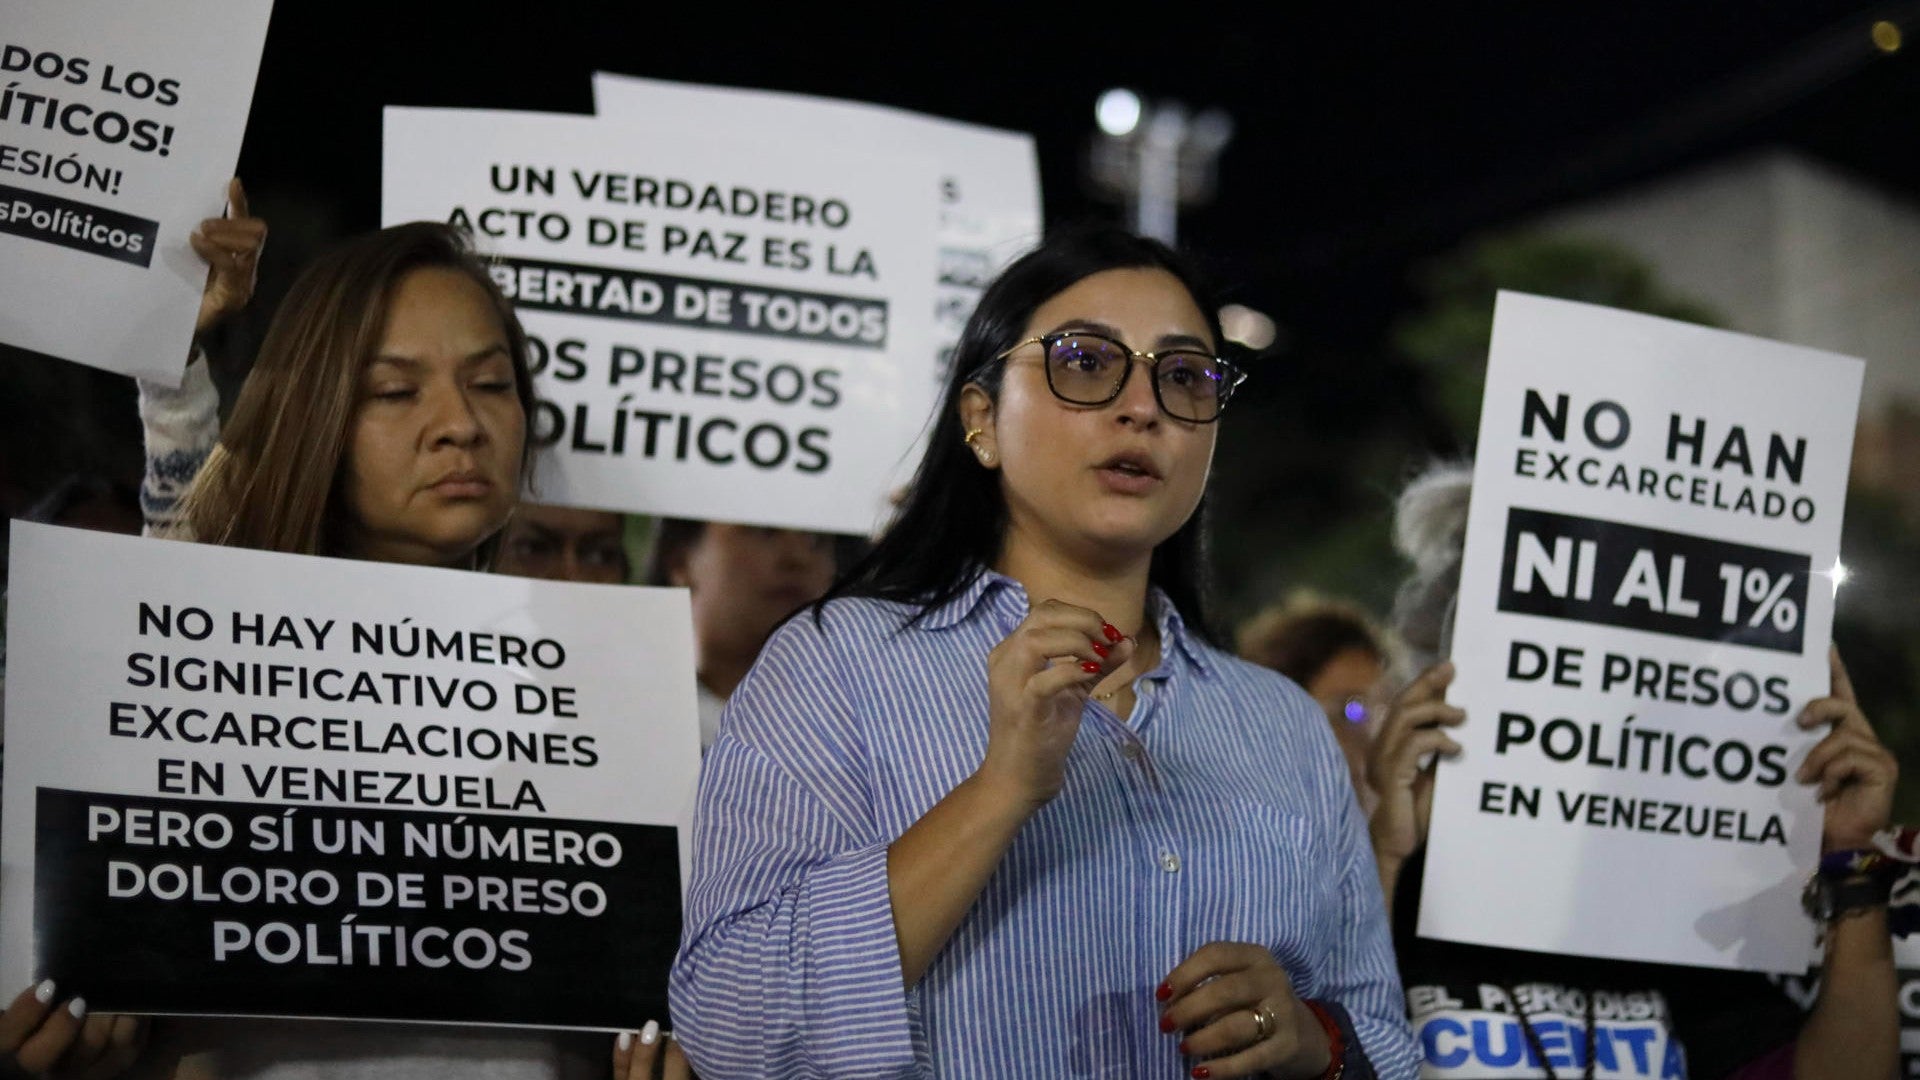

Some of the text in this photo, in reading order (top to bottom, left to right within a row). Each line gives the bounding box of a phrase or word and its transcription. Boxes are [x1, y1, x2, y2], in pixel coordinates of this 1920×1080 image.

[100, 64, 181, 106] LOS
[491, 165, 850, 228] UN VERDADERO
[449, 207, 880, 280] ACTO DE PAZ ES LA
[489, 264, 886, 341] BERTAD DE TODOS
[526, 335, 842, 411] OS PRESOS
[531, 394, 832, 475] OLÍTICOS
[1521, 388, 1808, 485] NO HAN
[1515, 448, 1817, 524] EXCARCELADO
[1513, 532, 1798, 633] NI AL 1%
[139, 602, 566, 670] NO HAY NÚMERO
[126, 652, 578, 719] SIGNIFICATIVO DE
[1507, 641, 1792, 715] DE PRESOS
[109, 701, 599, 768] EXCARCELACIONES
[1495, 712, 1788, 787] POLÍTICOS
[158, 758, 547, 813] EN VENEZUELA
[1480, 782, 1789, 847] EN VENEZUELA
[88, 805, 623, 868] PERO SÍ UN NÚMERO
[108, 860, 607, 917] DOLORO DE PRESO
[213, 913, 532, 971] POLÍTICOS
[1407, 985, 1463, 1015] EL
